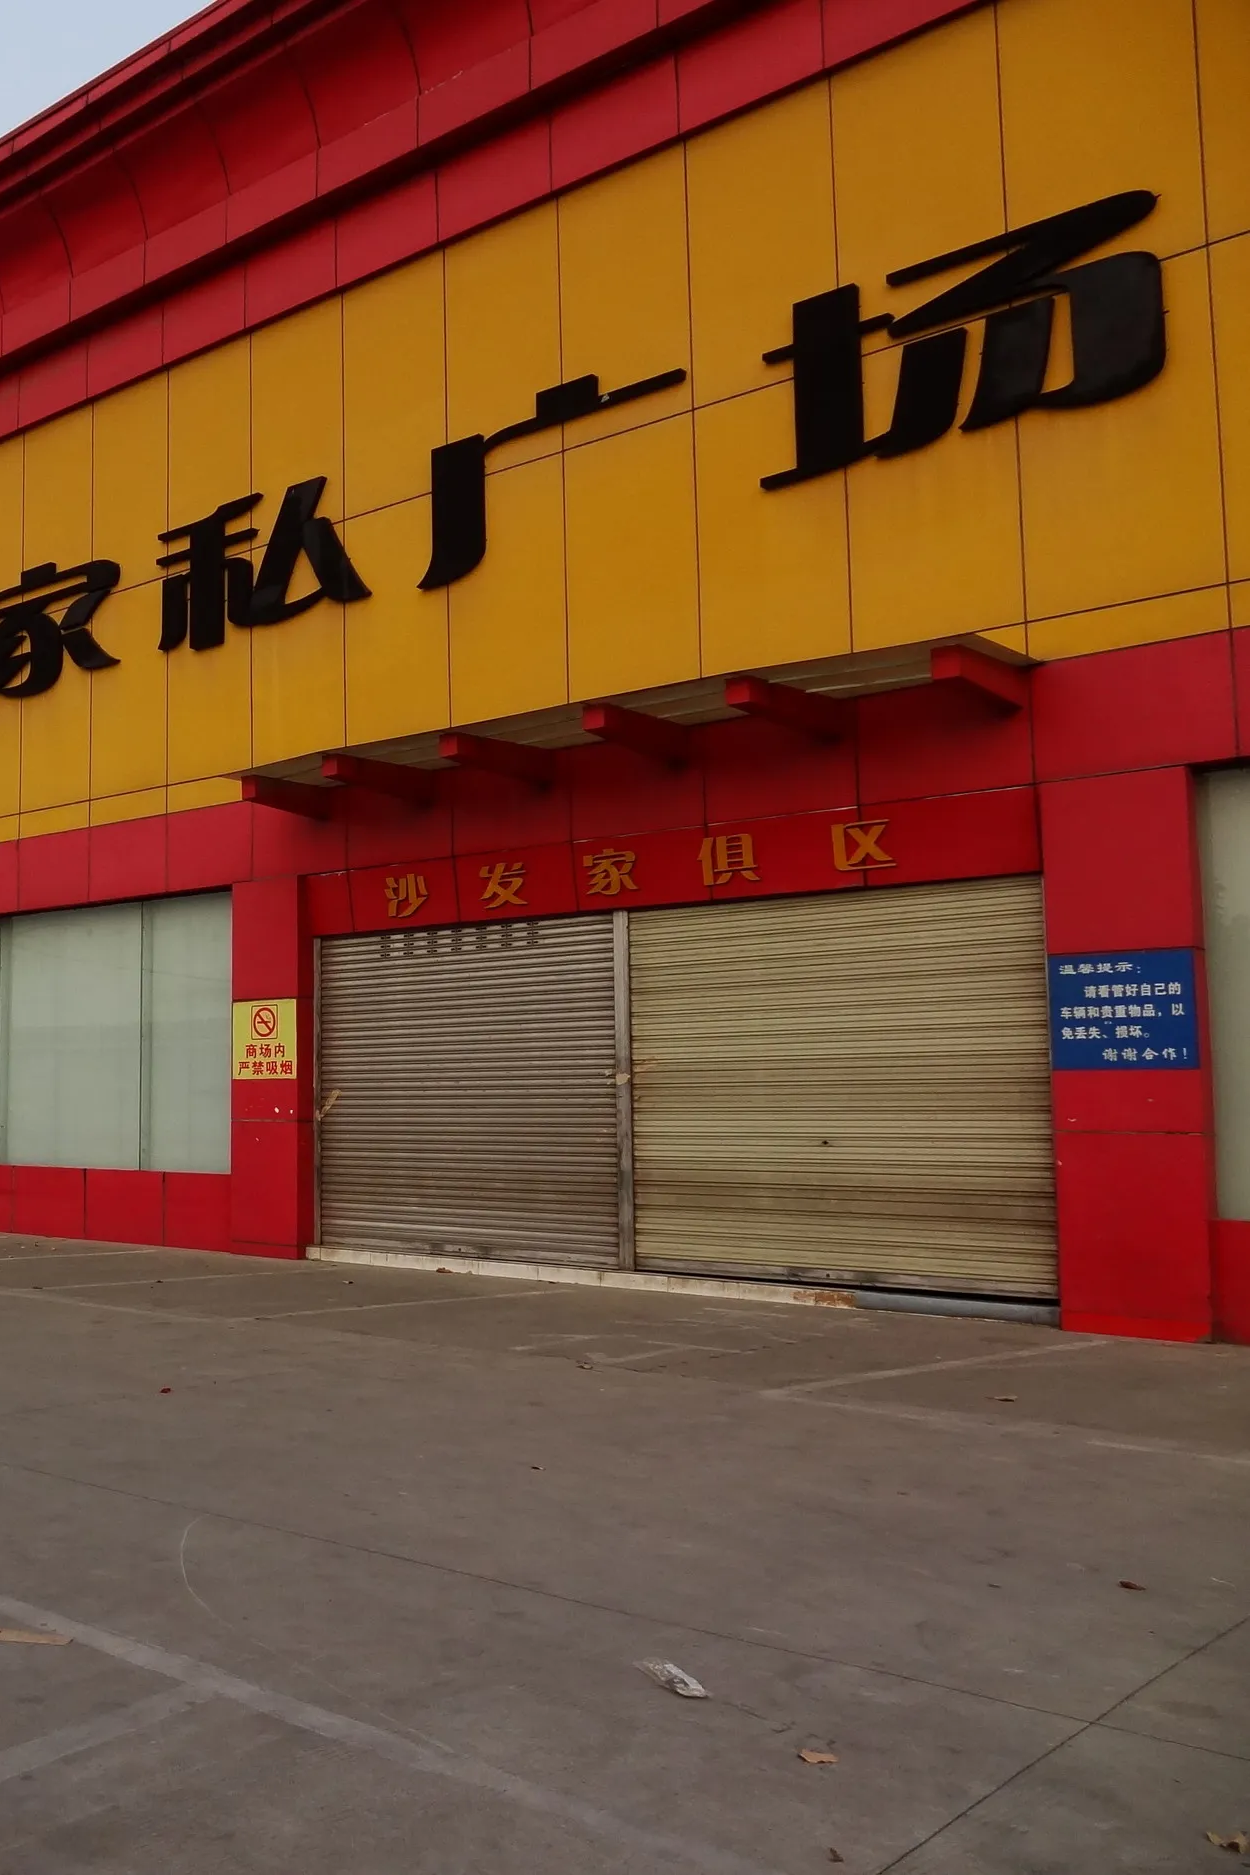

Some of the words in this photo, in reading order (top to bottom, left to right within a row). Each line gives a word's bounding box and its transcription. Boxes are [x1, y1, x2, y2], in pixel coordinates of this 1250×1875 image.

[384, 819, 898, 918] 沙发家俱区
[1084, 982, 1182, 998] 请看管好自己的
[245, 1043, 285, 1058] 商场内
[1102, 1047, 1188, 1061] 谢谢合作！
[238, 1060, 293, 1075] 严禁吸烟
